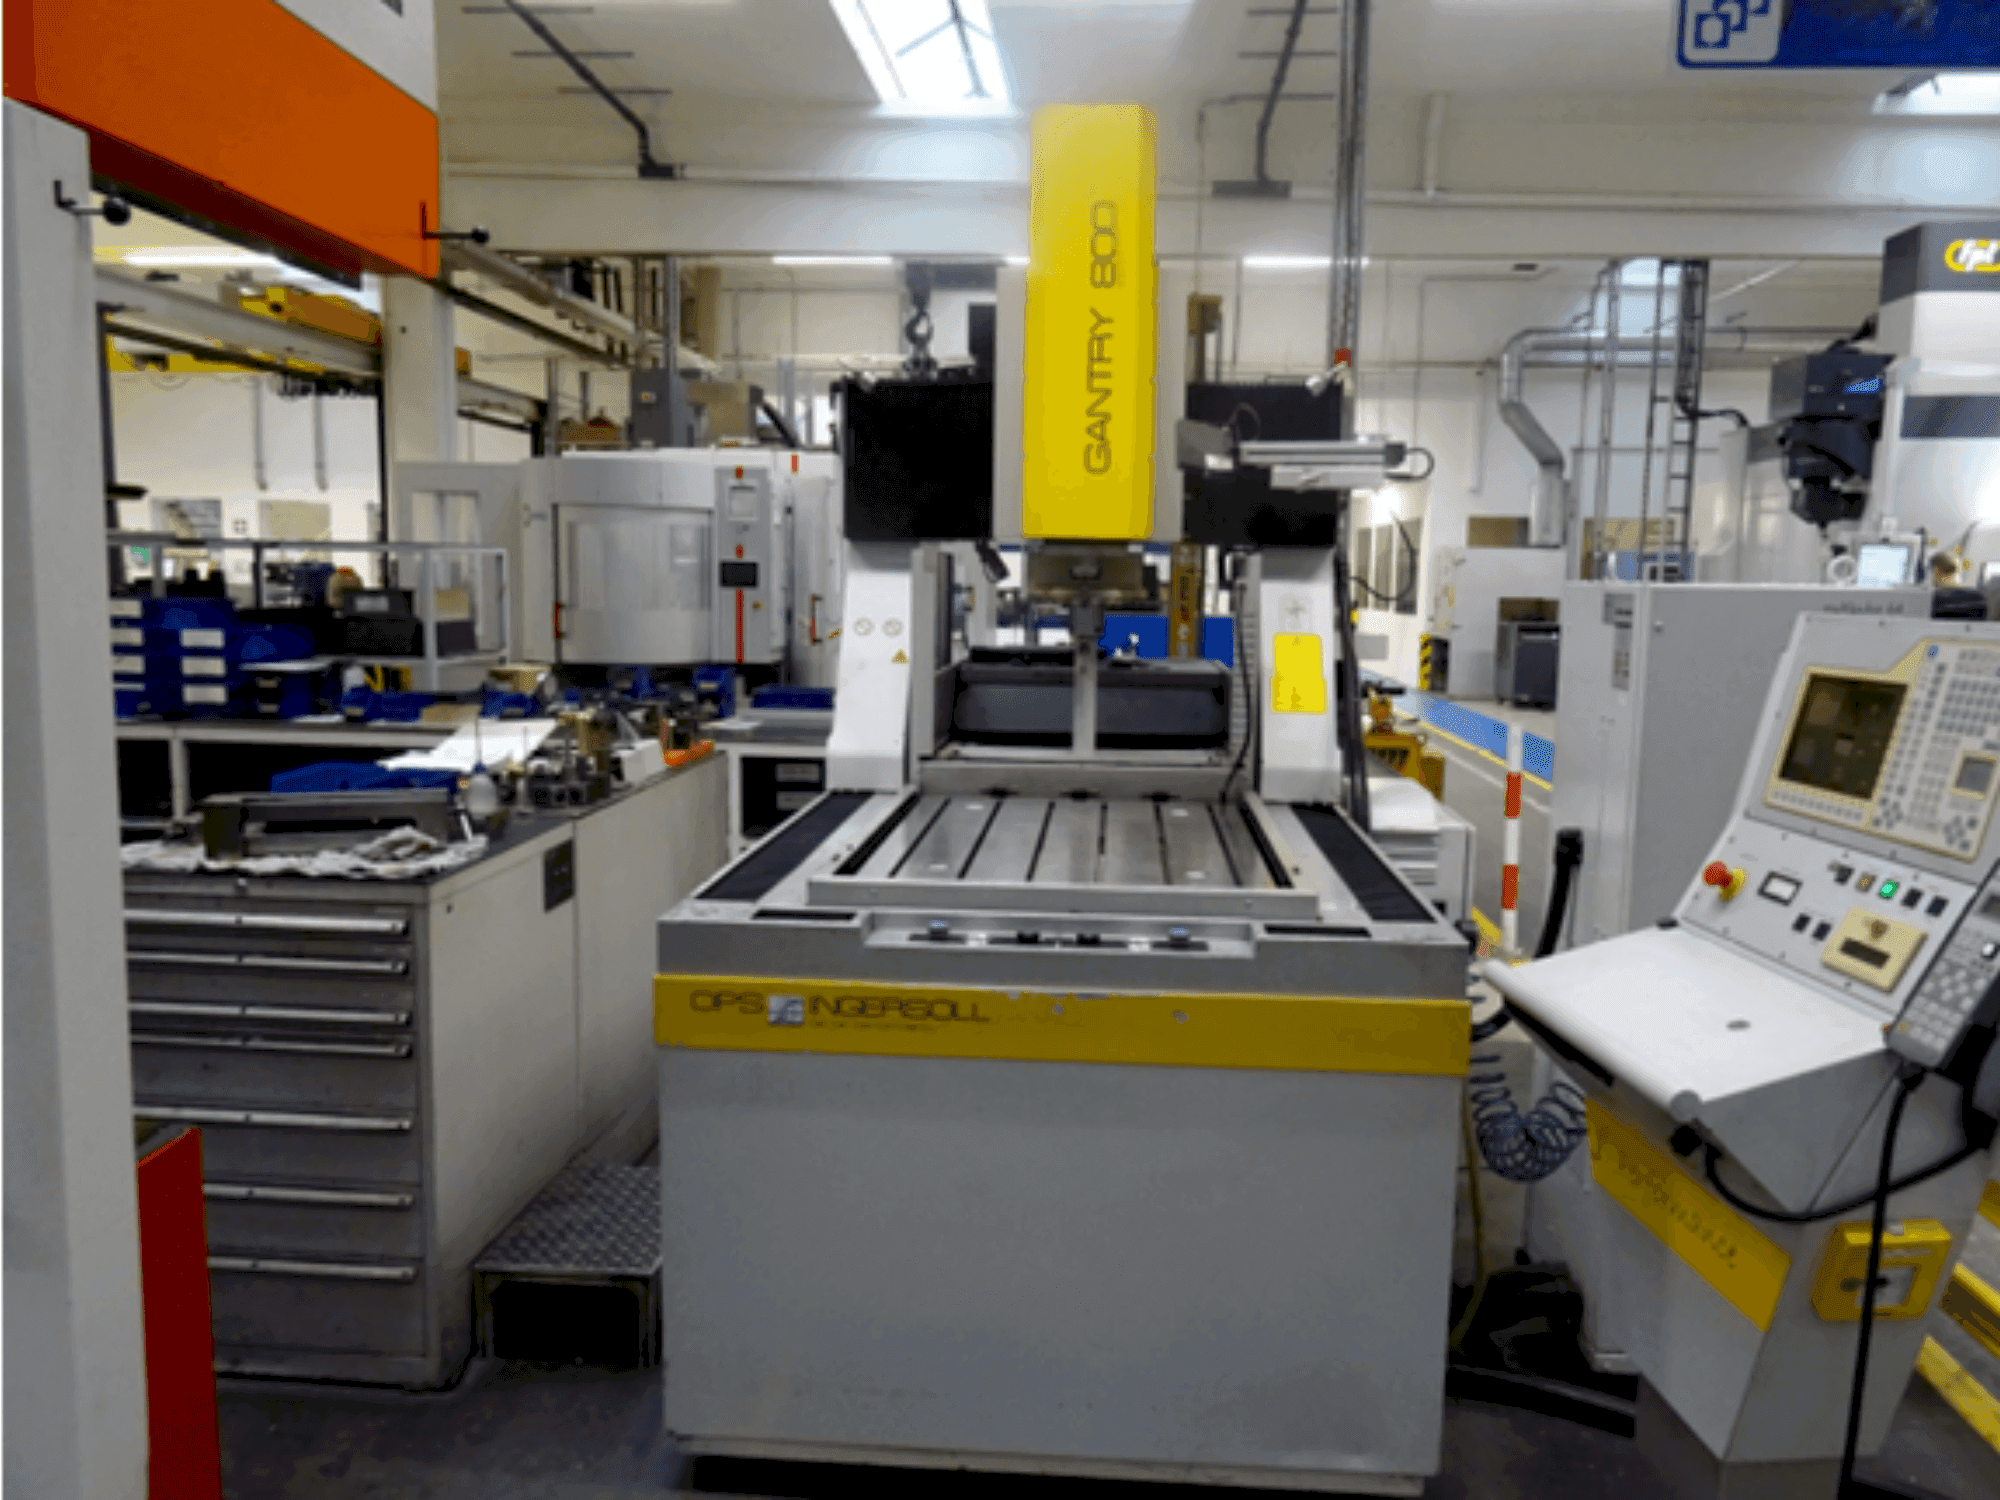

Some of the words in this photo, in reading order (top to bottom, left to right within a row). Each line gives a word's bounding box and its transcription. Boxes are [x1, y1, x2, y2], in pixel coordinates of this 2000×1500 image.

[1089, 200, 1118, 289] 800
[1084, 305, 1114, 475] GANTRY
[689, 989, 764, 1014] OPS
